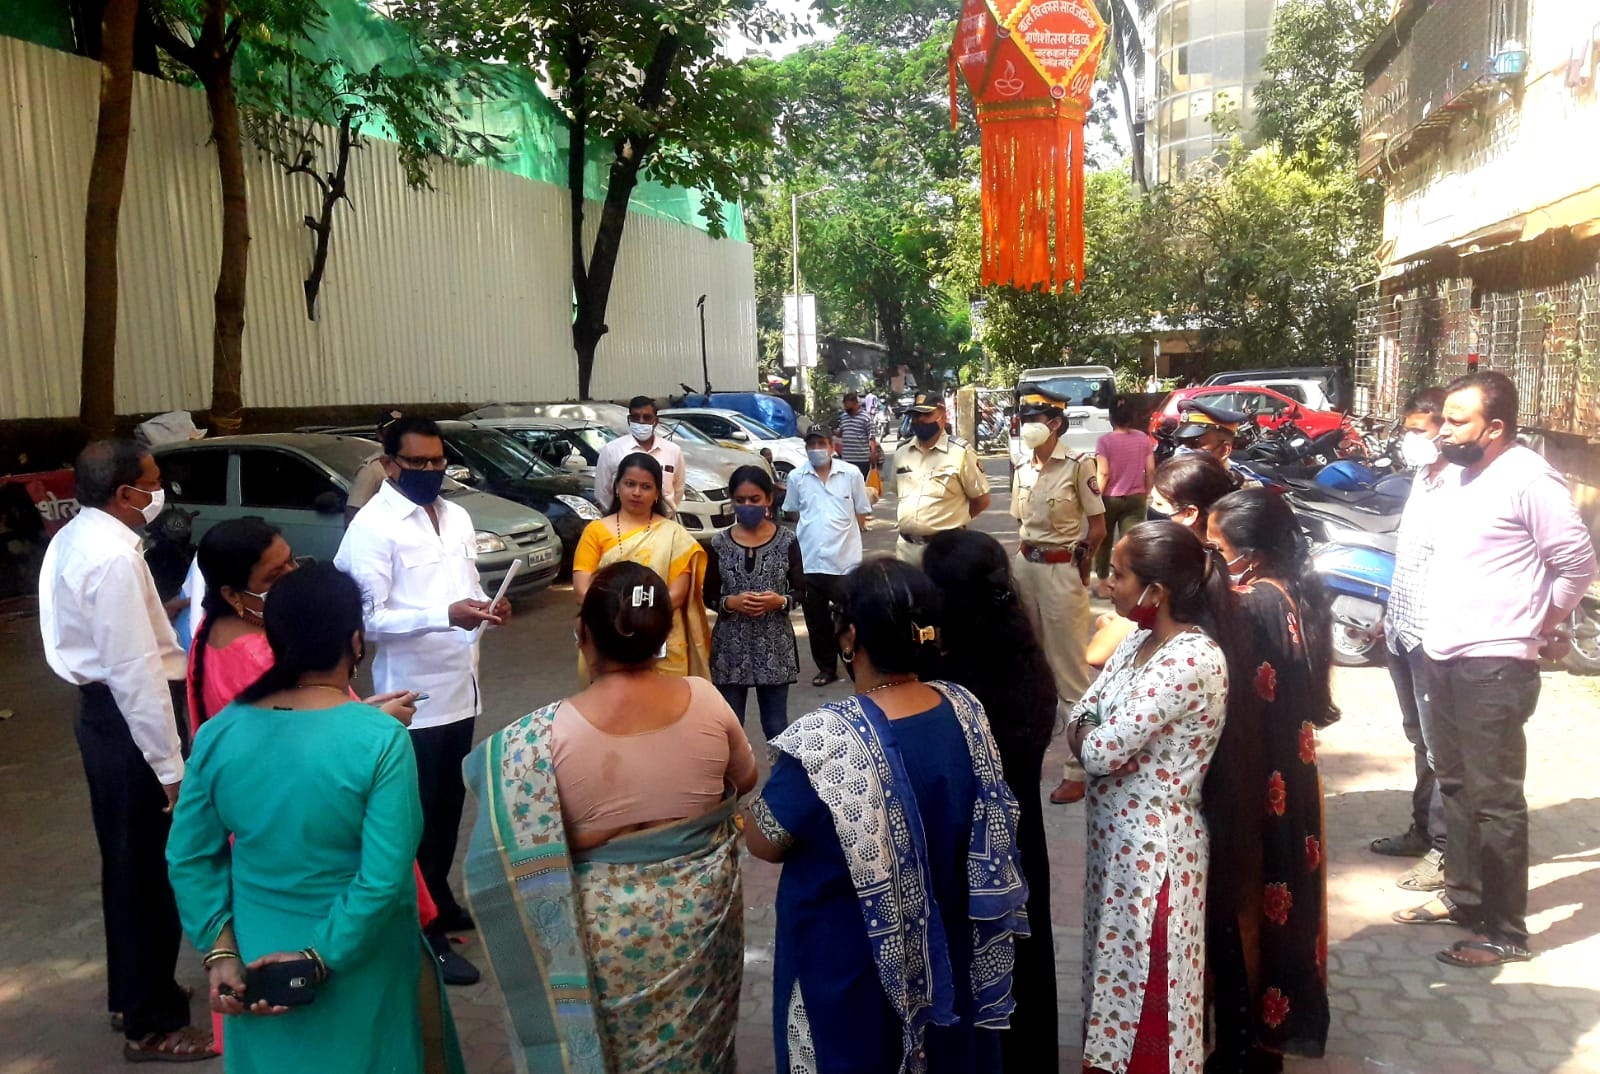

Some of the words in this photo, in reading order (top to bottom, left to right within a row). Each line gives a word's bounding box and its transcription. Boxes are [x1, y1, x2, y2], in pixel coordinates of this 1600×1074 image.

[1030, 0, 1059, 20] विकास
[1059, 0, 1096, 29] सार्वजनिक
[1025, 28, 1067, 45] गणेशोत्सव
[1068, 29, 1090, 46] मंडळ
